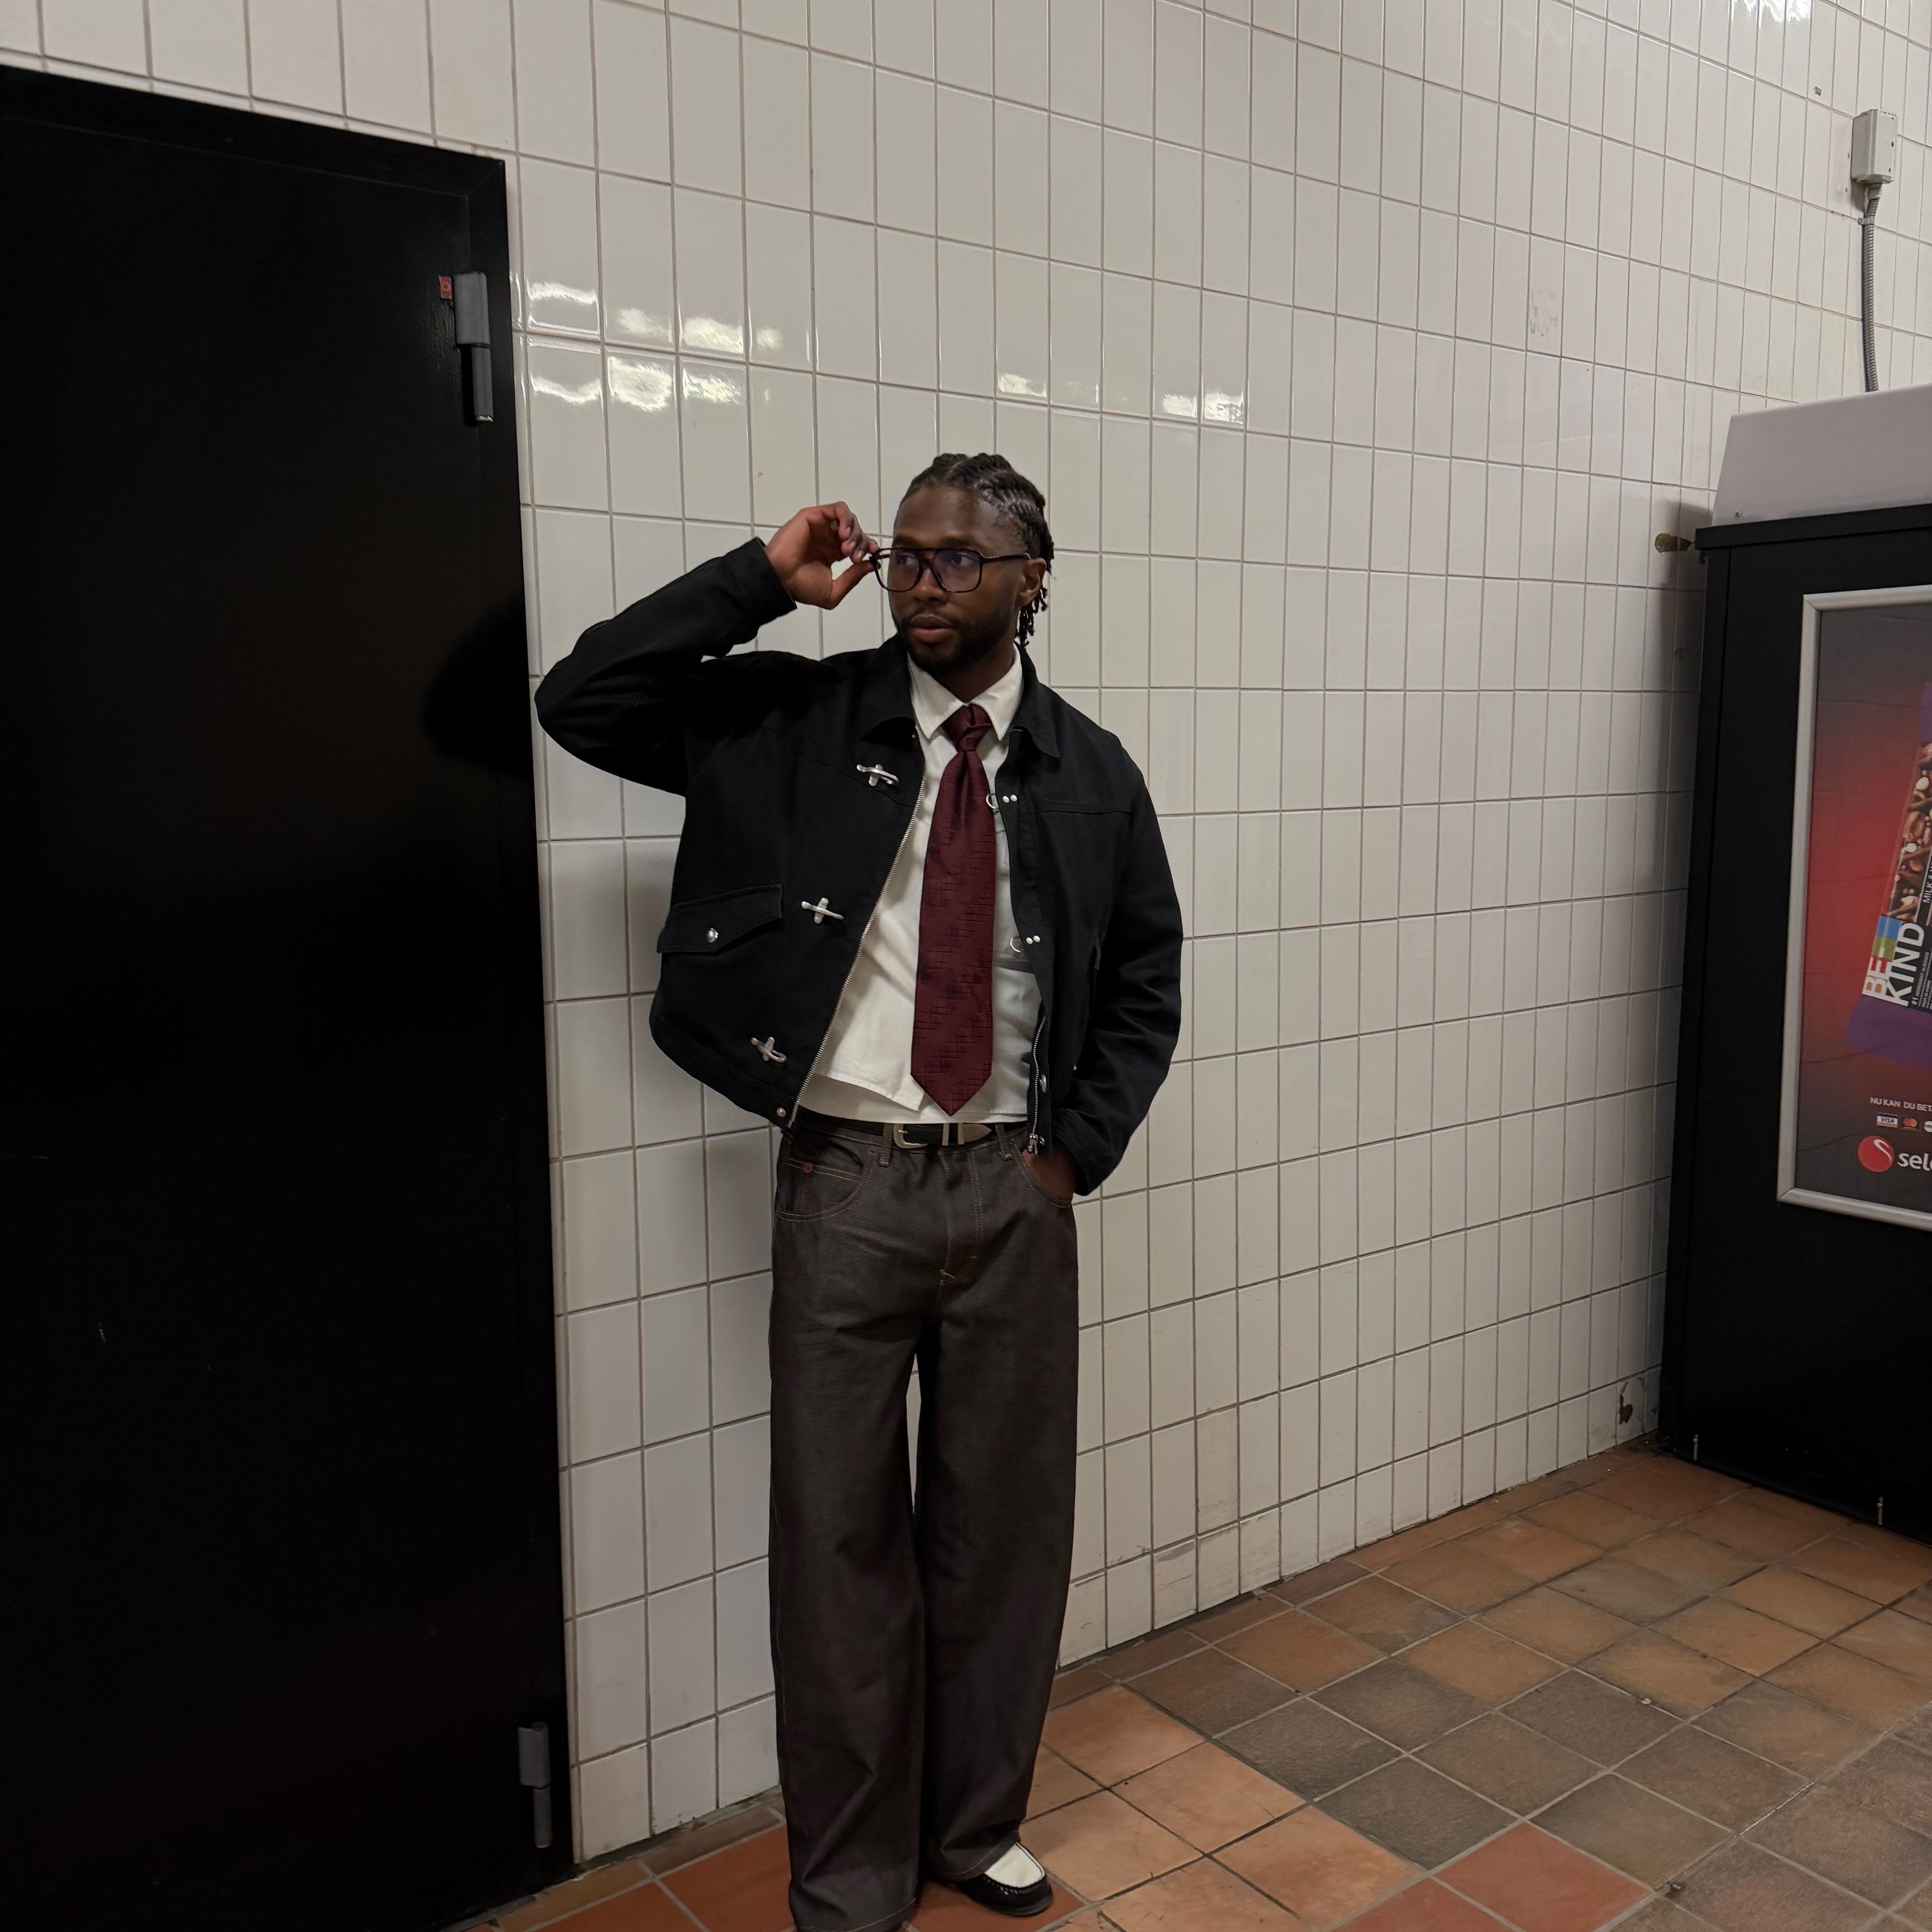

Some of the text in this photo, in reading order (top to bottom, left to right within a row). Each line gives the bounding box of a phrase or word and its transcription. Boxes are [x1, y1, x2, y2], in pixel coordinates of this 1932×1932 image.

[1885, 922, 1924, 1007] KIND
[1870, 1097, 1932, 1112] NU KAN DU BET
[1897, 1153, 1932, 1171] sel
